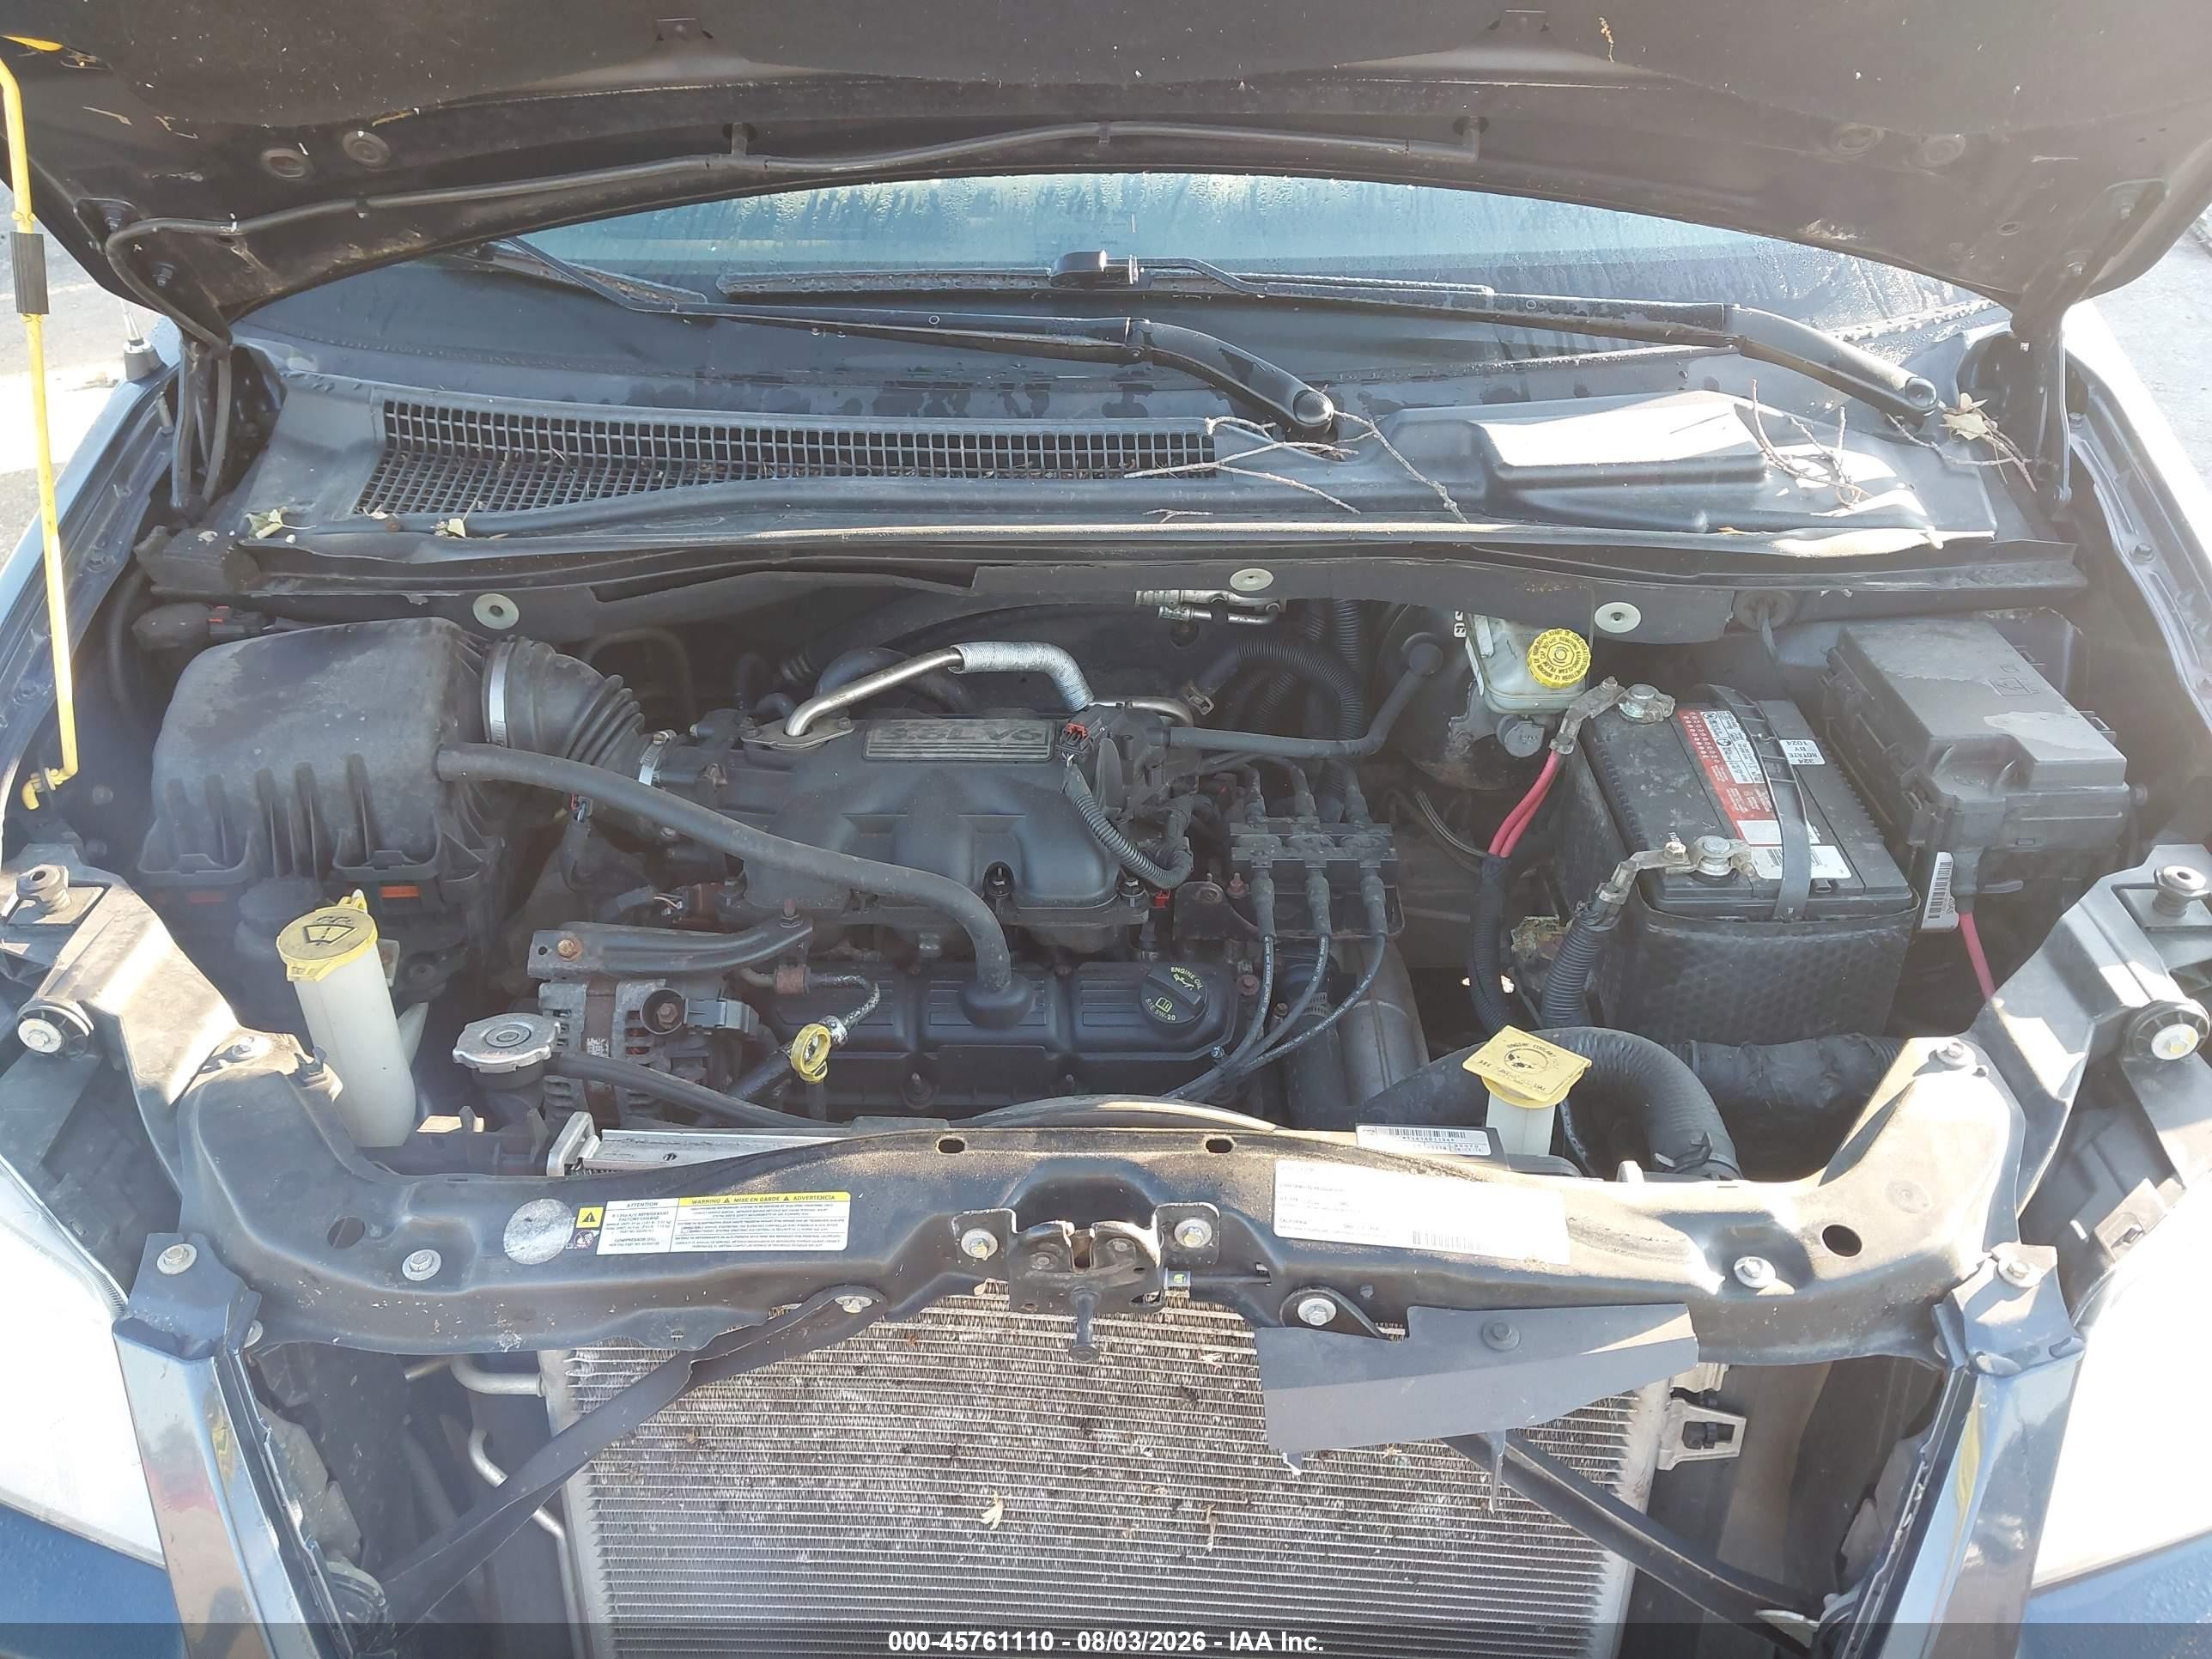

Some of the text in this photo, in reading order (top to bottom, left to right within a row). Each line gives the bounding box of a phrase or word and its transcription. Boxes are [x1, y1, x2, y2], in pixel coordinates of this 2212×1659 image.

[1170, 966, 1204, 990] ENGINE OIL
[1154, 1008, 1176, 1021] 5W-20
